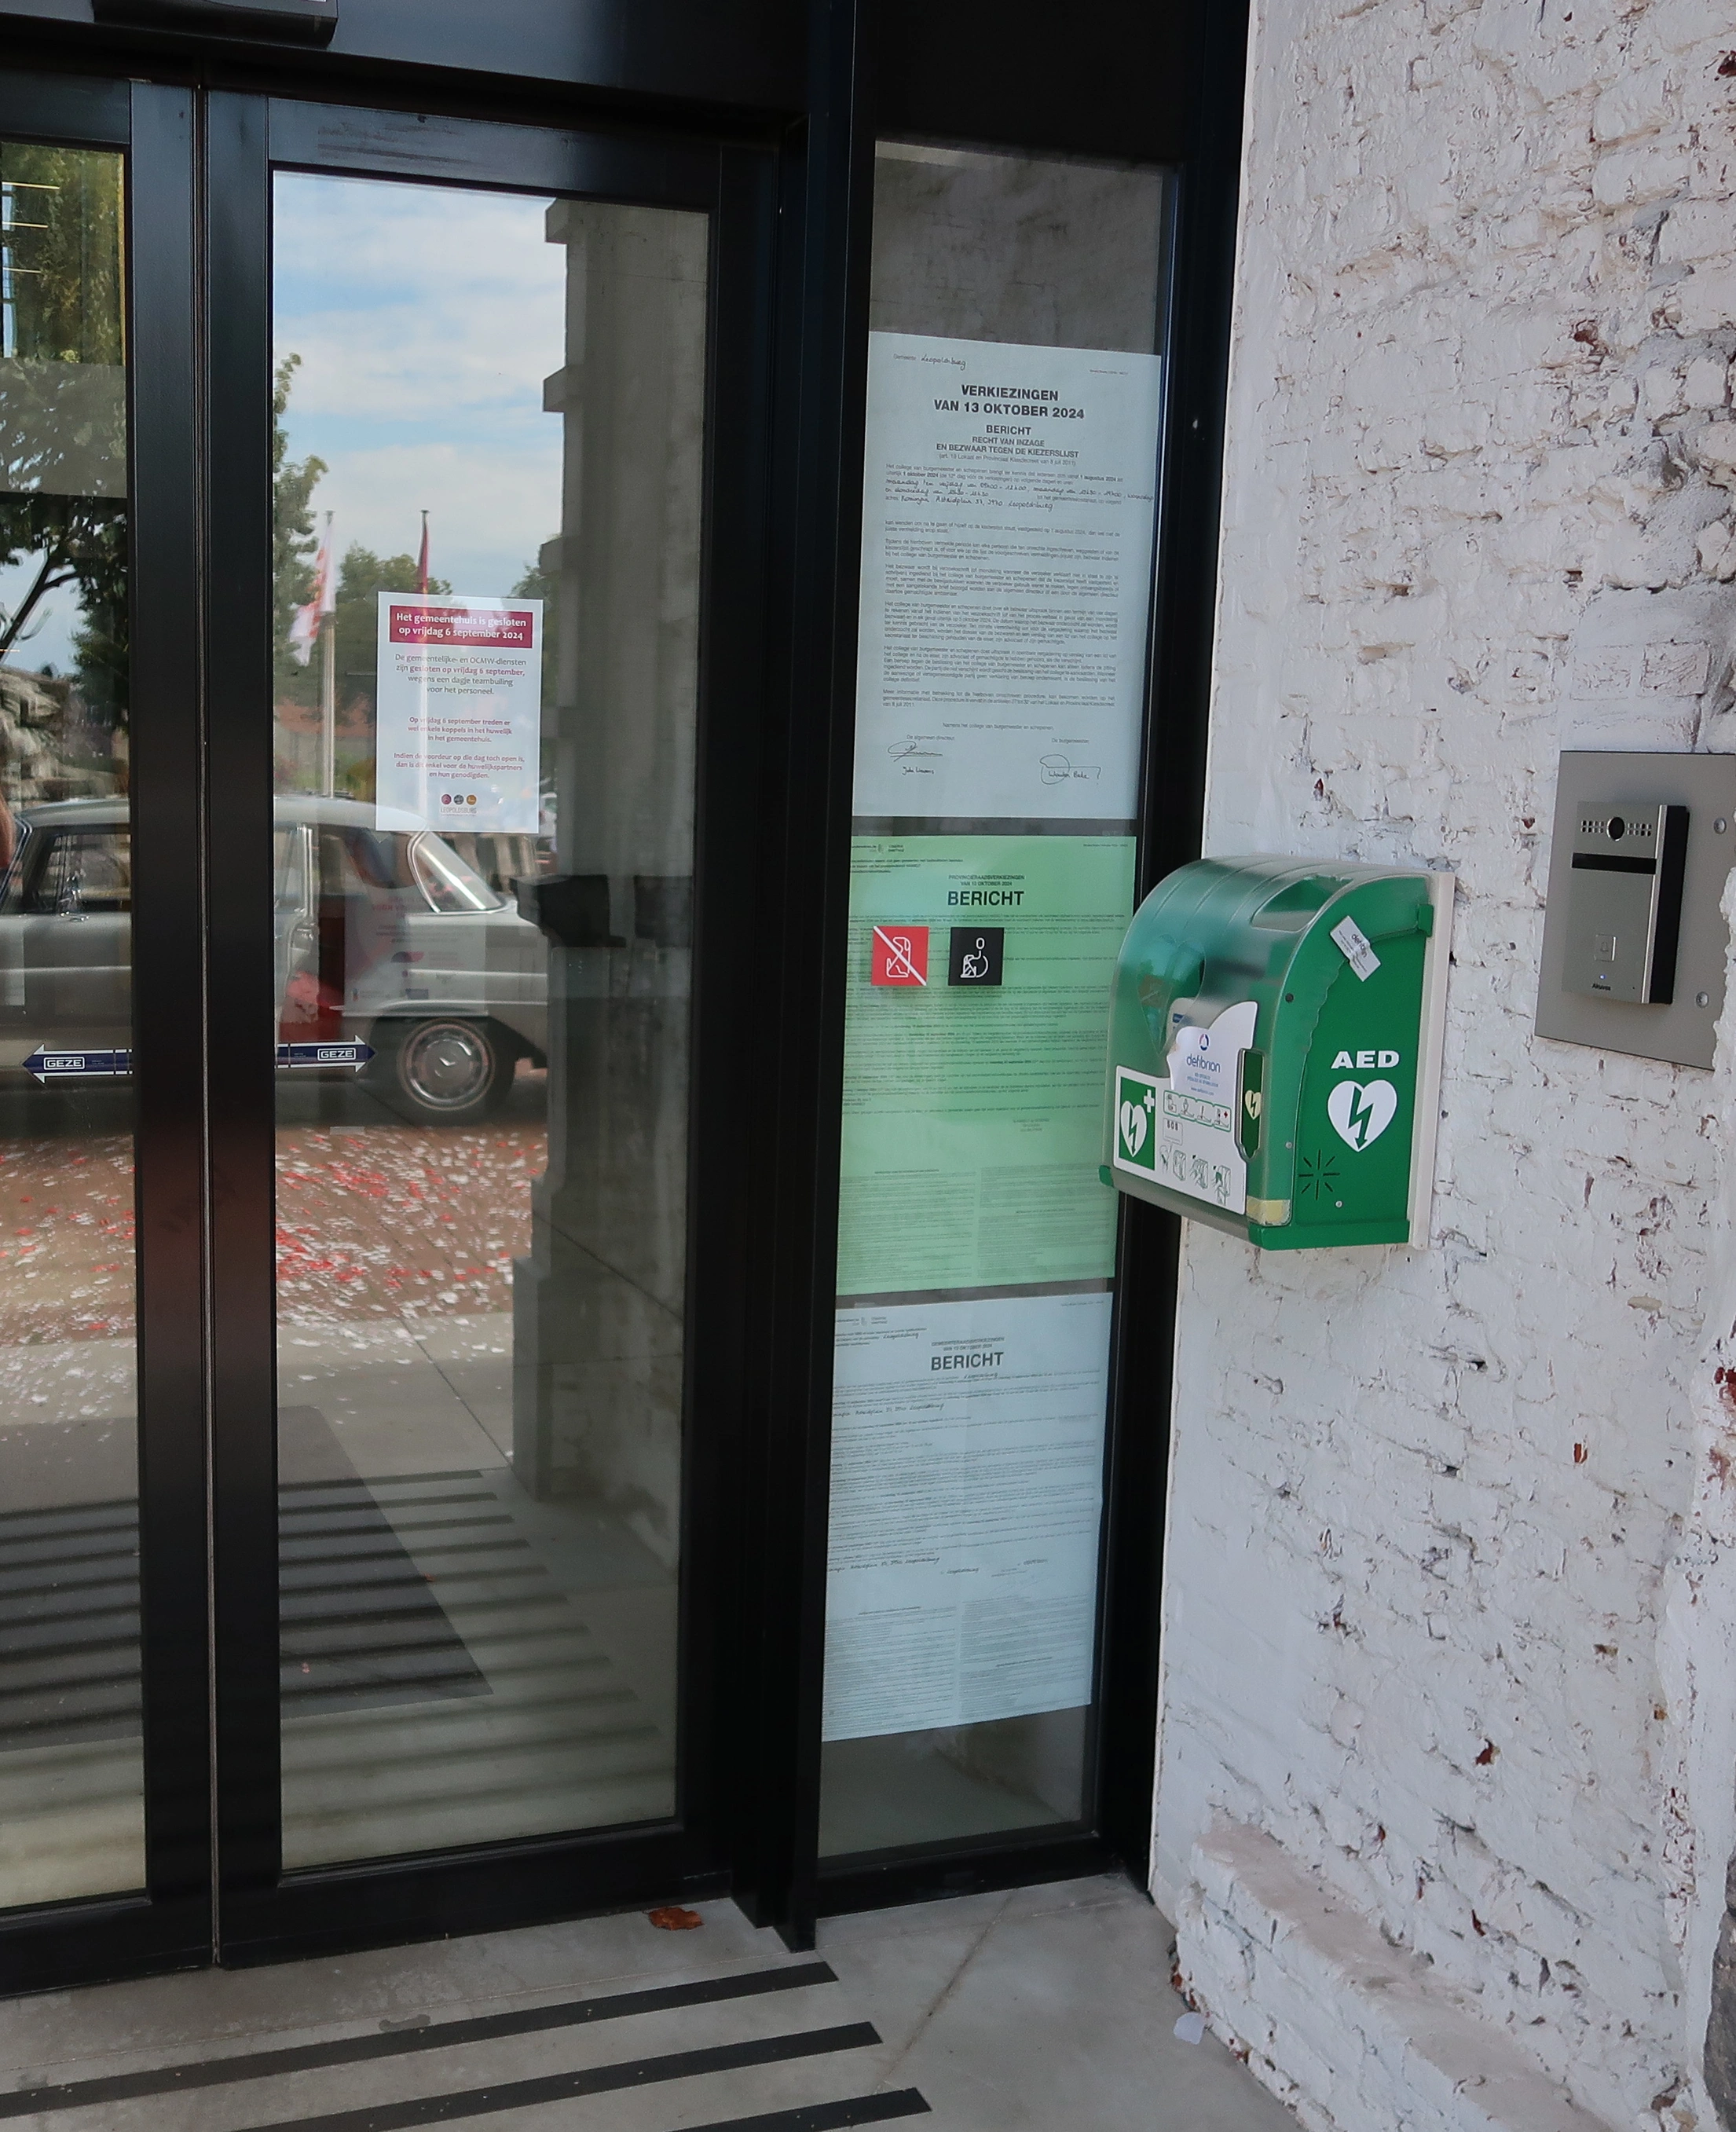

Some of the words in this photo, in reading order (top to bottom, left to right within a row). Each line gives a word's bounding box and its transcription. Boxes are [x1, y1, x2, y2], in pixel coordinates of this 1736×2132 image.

[961, 385, 1058, 401] VERKIEZINGEN
[935, 401, 958, 411] VAN
[965, 402, 979, 412] 13
[984, 403, 1048, 416] OKTOBER
[1053, 407, 1084, 418] 2024
[986, 425, 1031, 434] BERICHT
[1028, 449, 1079, 457] KIEZERSLIJST
[415, 615, 477, 624] gemeentehuis
[488, 618, 526, 628] gesloten
[413, 627, 443, 638] vrijdag
[453, 629, 500, 639] september
[503, 632, 523, 640] 2024
[486, 669, 525, 677] september,
[948, 891, 1024, 906] BERICHT
[319, 1050, 354, 1059] GEZE
[1331, 1050, 1399, 1068] AED
[47, 1059, 82, 1068] GEZE
[1186, 1053, 1220, 1073] defibrion
[932, 1352, 1004, 1371] BERICHT
